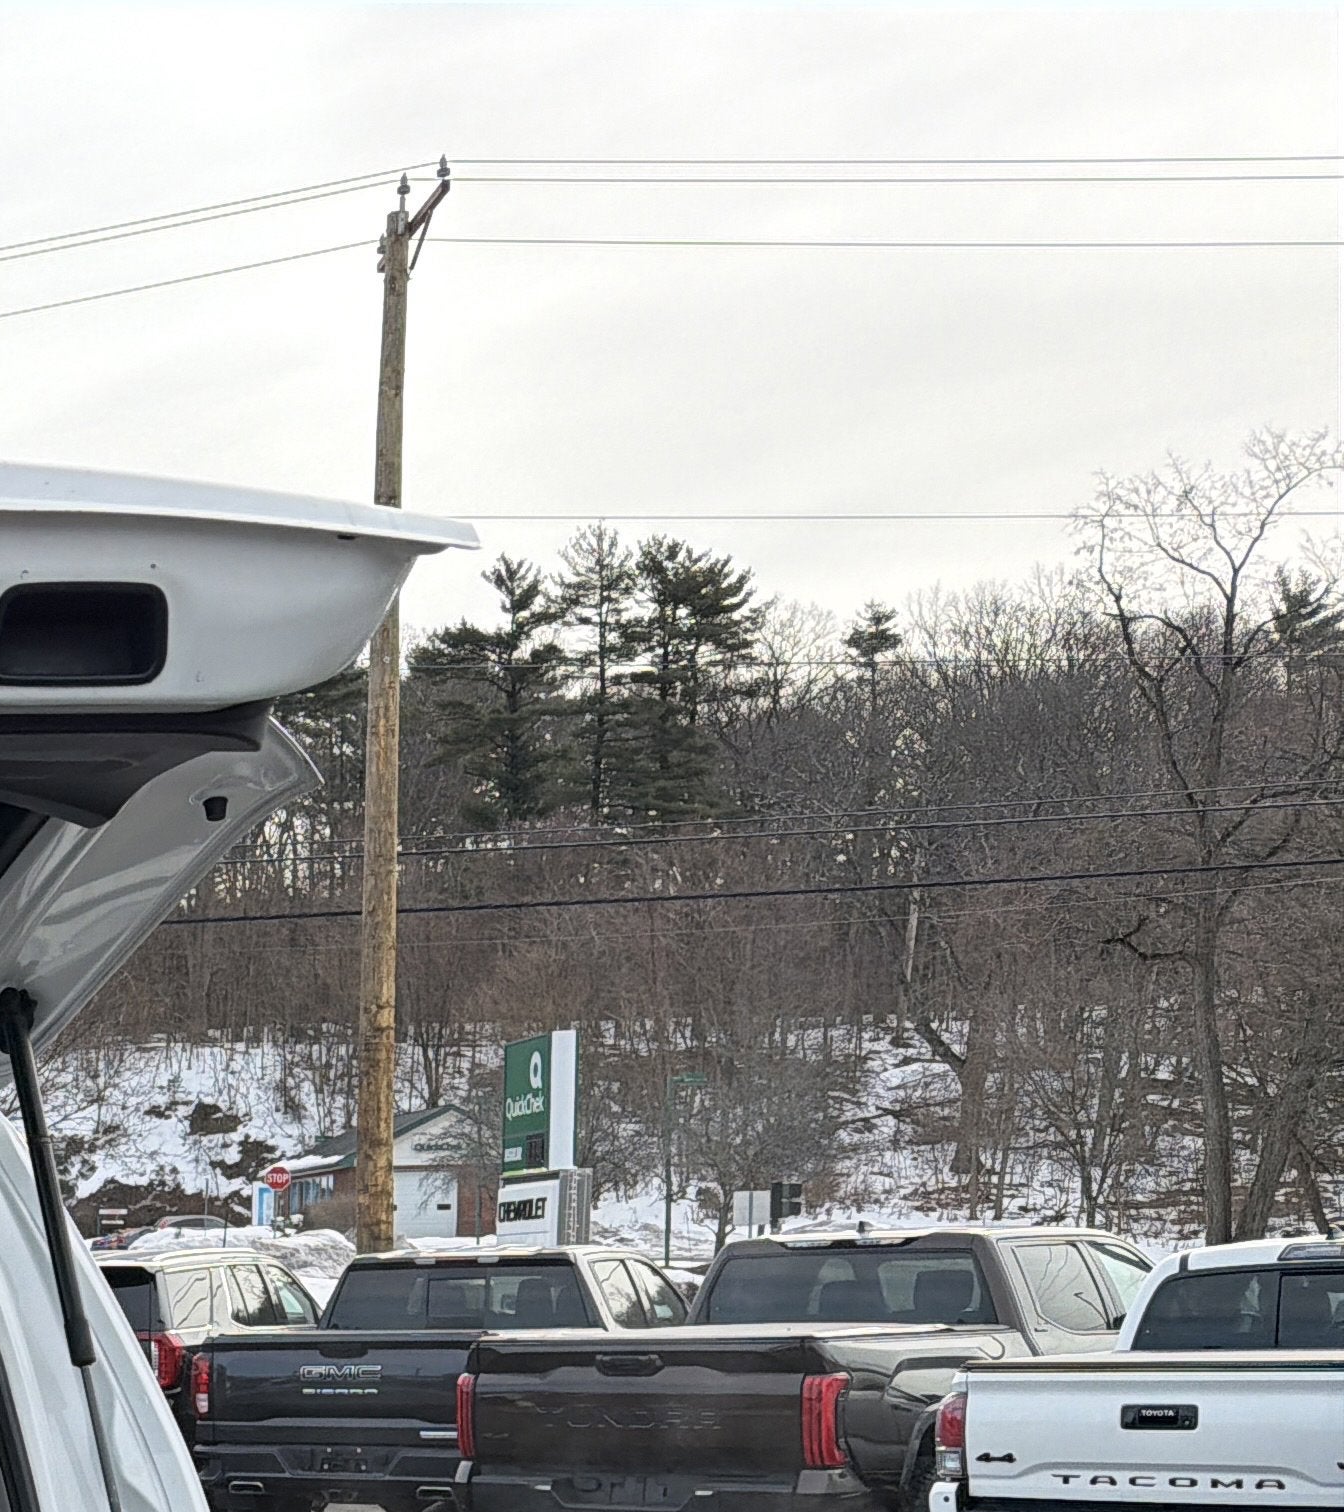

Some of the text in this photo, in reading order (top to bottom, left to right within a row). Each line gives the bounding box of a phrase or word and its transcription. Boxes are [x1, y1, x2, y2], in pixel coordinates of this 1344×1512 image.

[505, 1091, 545, 1120] QuickChek
[266, 1173, 290, 1184] STOP
[498, 1197, 547, 1223] CHEVROLET
[299, 1365, 382, 1381] GMC
[1140, 1409, 1175, 1417] TOYOTA
[1051, 1473, 1286, 1490] TACOMA
